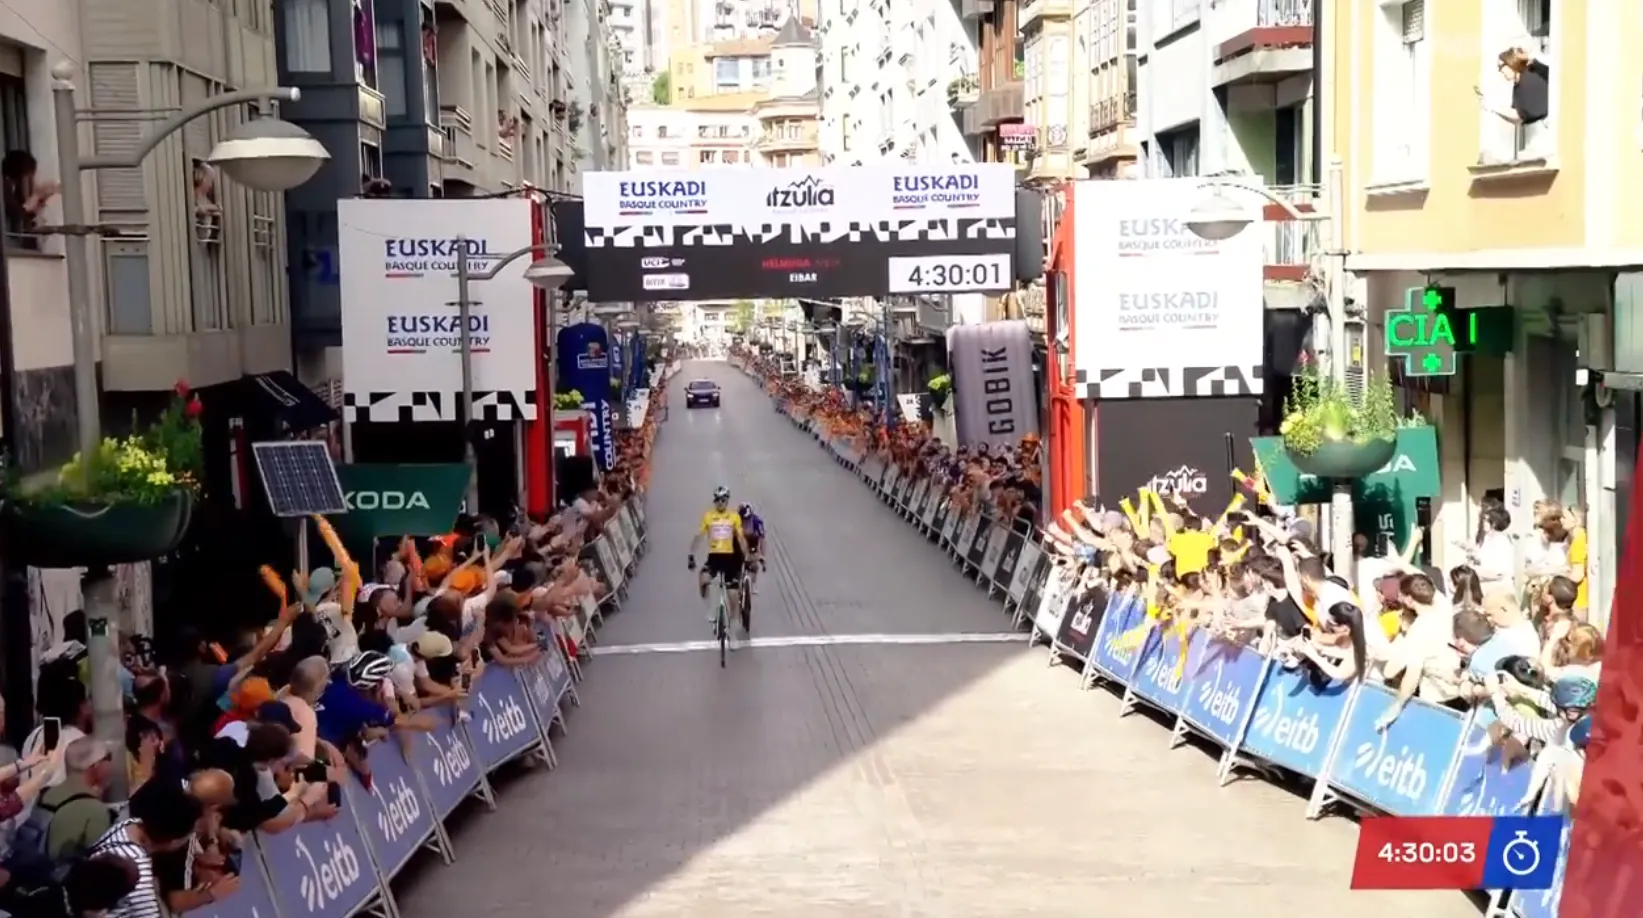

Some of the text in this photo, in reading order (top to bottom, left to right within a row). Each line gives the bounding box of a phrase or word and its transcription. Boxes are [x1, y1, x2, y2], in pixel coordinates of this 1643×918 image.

[619, 181, 706, 197] EUSKADI
[893, 174, 979, 191] EUSKADI
[619, 199, 708, 209] BASQUE COUNTRY
[766, 185, 835, 207] itzulia
[893, 193, 979, 203] BASQUE COUNTRY
[1118, 239, 1160, 250] BASQUE
[385, 260, 488, 271] BASQUE COUTRY
[908, 263, 1000, 287] 4:30:01
[789, 272, 817, 282] EIBAR
[1119, 291, 1218, 310] EUSKADI
[1118, 312, 1219, 324] BASQUE COUNTRY
[387, 338, 430, 347] BASQUE
[981, 346, 1015, 434] GOBIK
[343, 491, 431, 510] KODA
[1210, 680, 1241, 725] eitb
[497, 694, 526, 741] eitb
[1273, 706, 1319, 755] eitb
[446, 729, 471, 779] eitb
[1378, 744, 1427, 801] eitb
[388, 775, 420, 835] eitb
[320, 832, 360, 900] eitb
